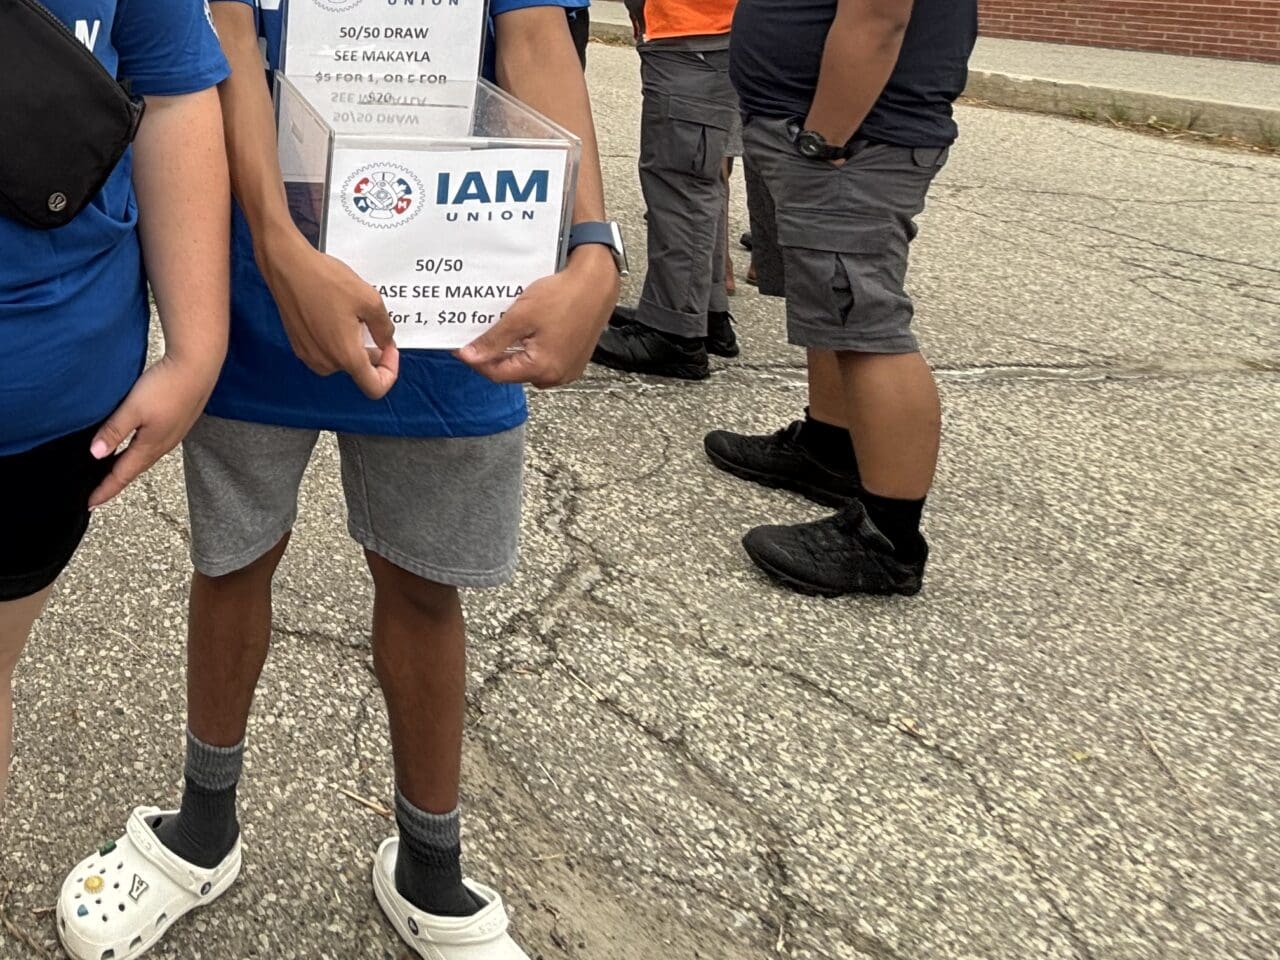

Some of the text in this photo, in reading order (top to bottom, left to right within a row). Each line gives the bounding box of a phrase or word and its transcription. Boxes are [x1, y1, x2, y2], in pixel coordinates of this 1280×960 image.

[339, 26, 430, 40] 50/50 DRAW
[334, 50, 431, 62] SEE MAKAYLA
[335, 73, 363, 83] FOR
[436, 170, 549, 205] IAM
[446, 210, 534, 222] UNION
[415, 257, 463, 274] 50/50
[372, 285, 524, 298] ASE SEE MAKAYLA
[414, 311, 428, 325] 1,
[437, 310, 467, 326] $20
[472, 311, 495, 324] for
